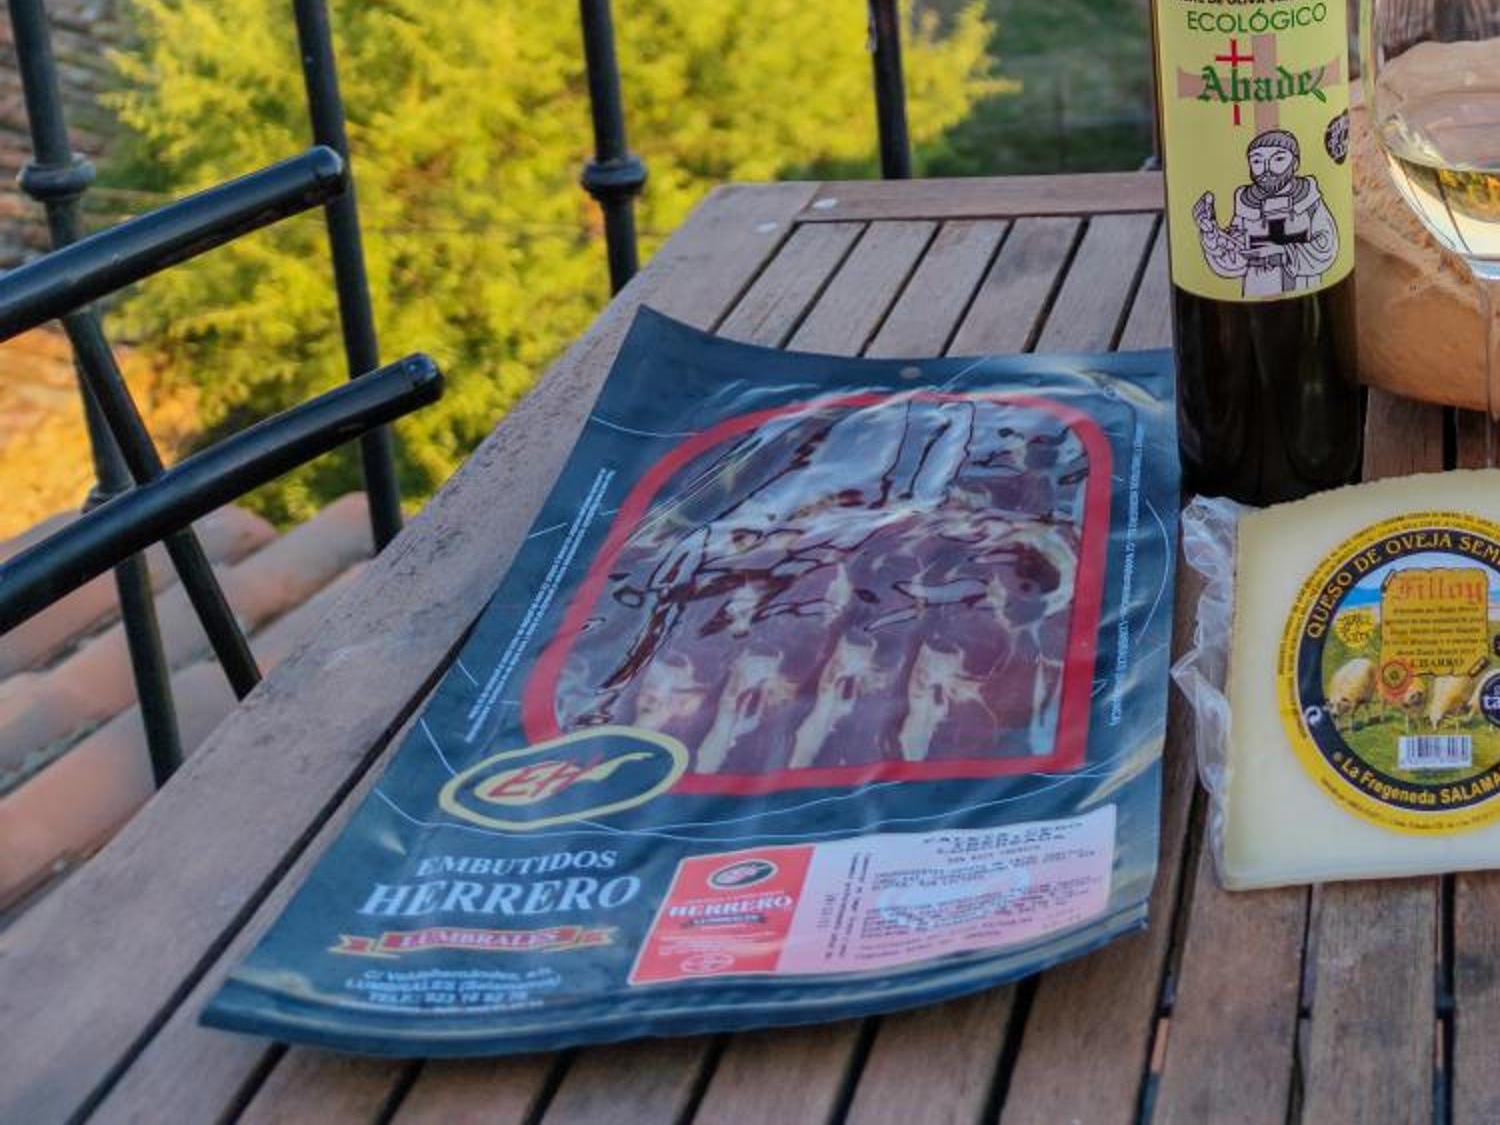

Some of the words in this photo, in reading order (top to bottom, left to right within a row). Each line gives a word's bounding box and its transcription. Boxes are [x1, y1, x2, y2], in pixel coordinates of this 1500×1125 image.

[1187, 2, 1327, 33] ECOLÓGICO
[1307, 572, 1353, 638] QUESO
[1353, 548, 1383, 572] DE
[1385, 533, 1452, 555] OVEJA
[1340, 757, 1359, 778] La
[416, 850, 618, 877] EMBUTIDOS
[356, 876, 641, 916] HERRERO
[669, 895, 793, 917] HERRERO
